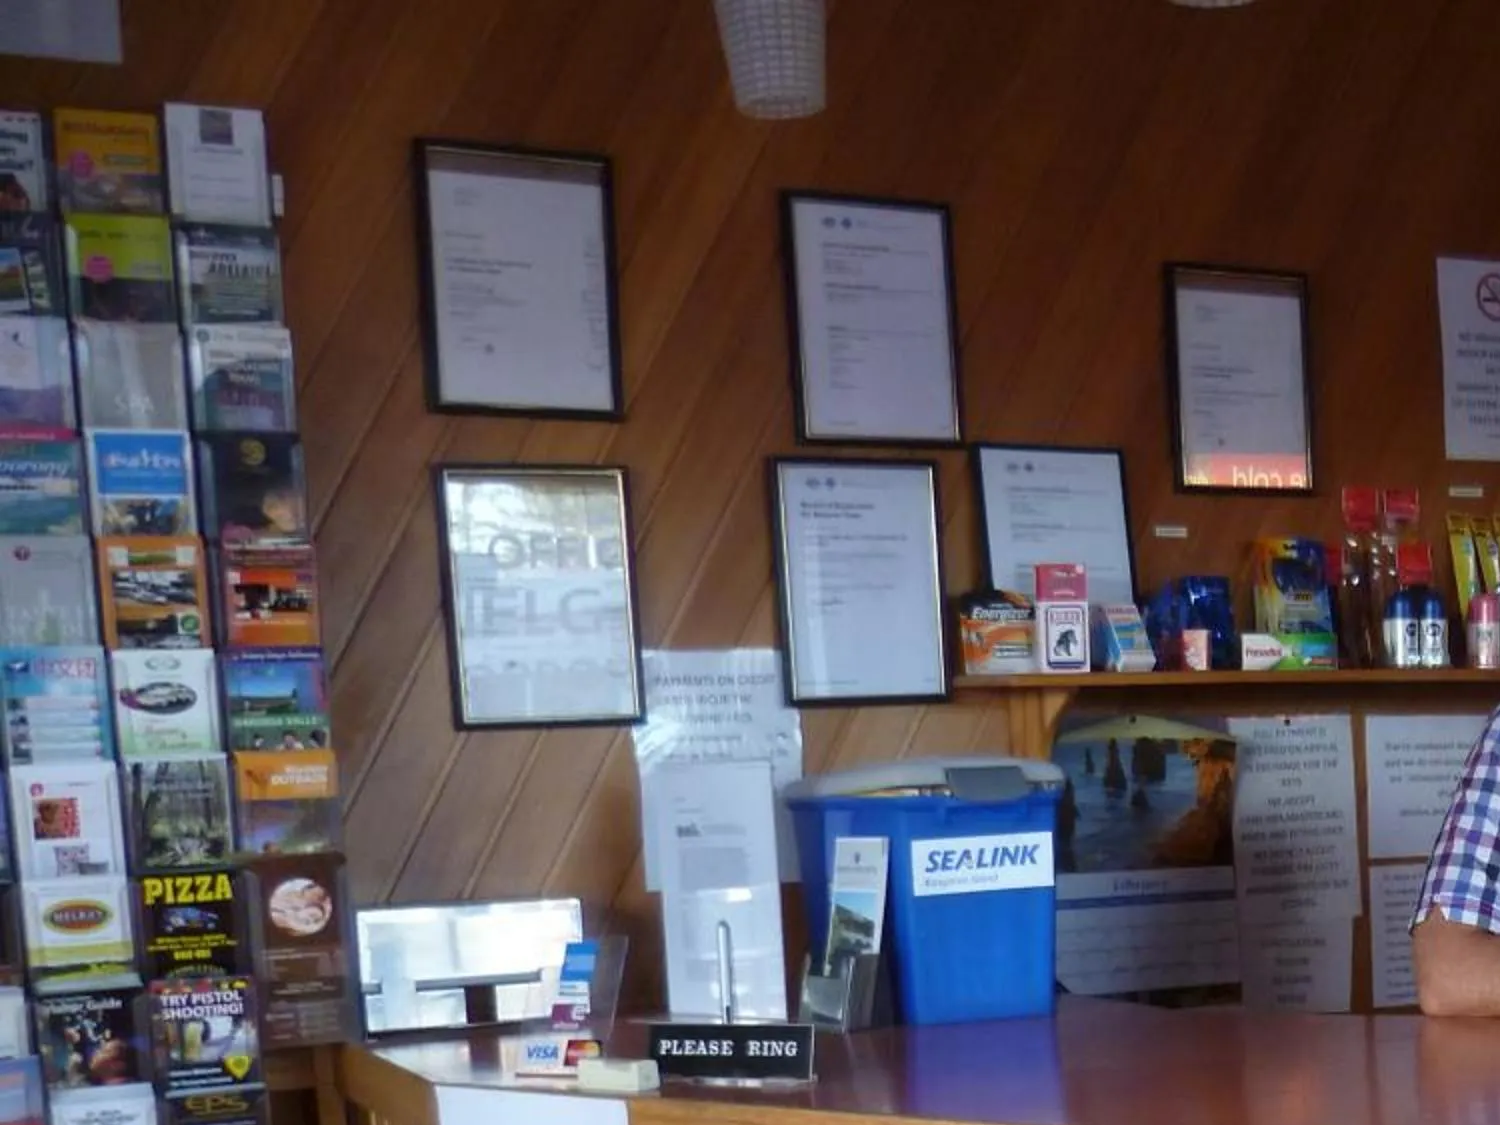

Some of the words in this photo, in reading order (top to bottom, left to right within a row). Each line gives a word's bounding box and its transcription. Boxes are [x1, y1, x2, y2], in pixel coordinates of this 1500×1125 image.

[925, 844, 1041, 873] SEALINK
[143, 873, 233, 905] PIZZA
[160, 994, 189, 1007] TRY
[190, 989, 243, 1005] PISTOL
[526, 1045, 560, 1060] VISA
[659, 1038, 734, 1058] PLEASE
[746, 1040, 799, 1058] RING
